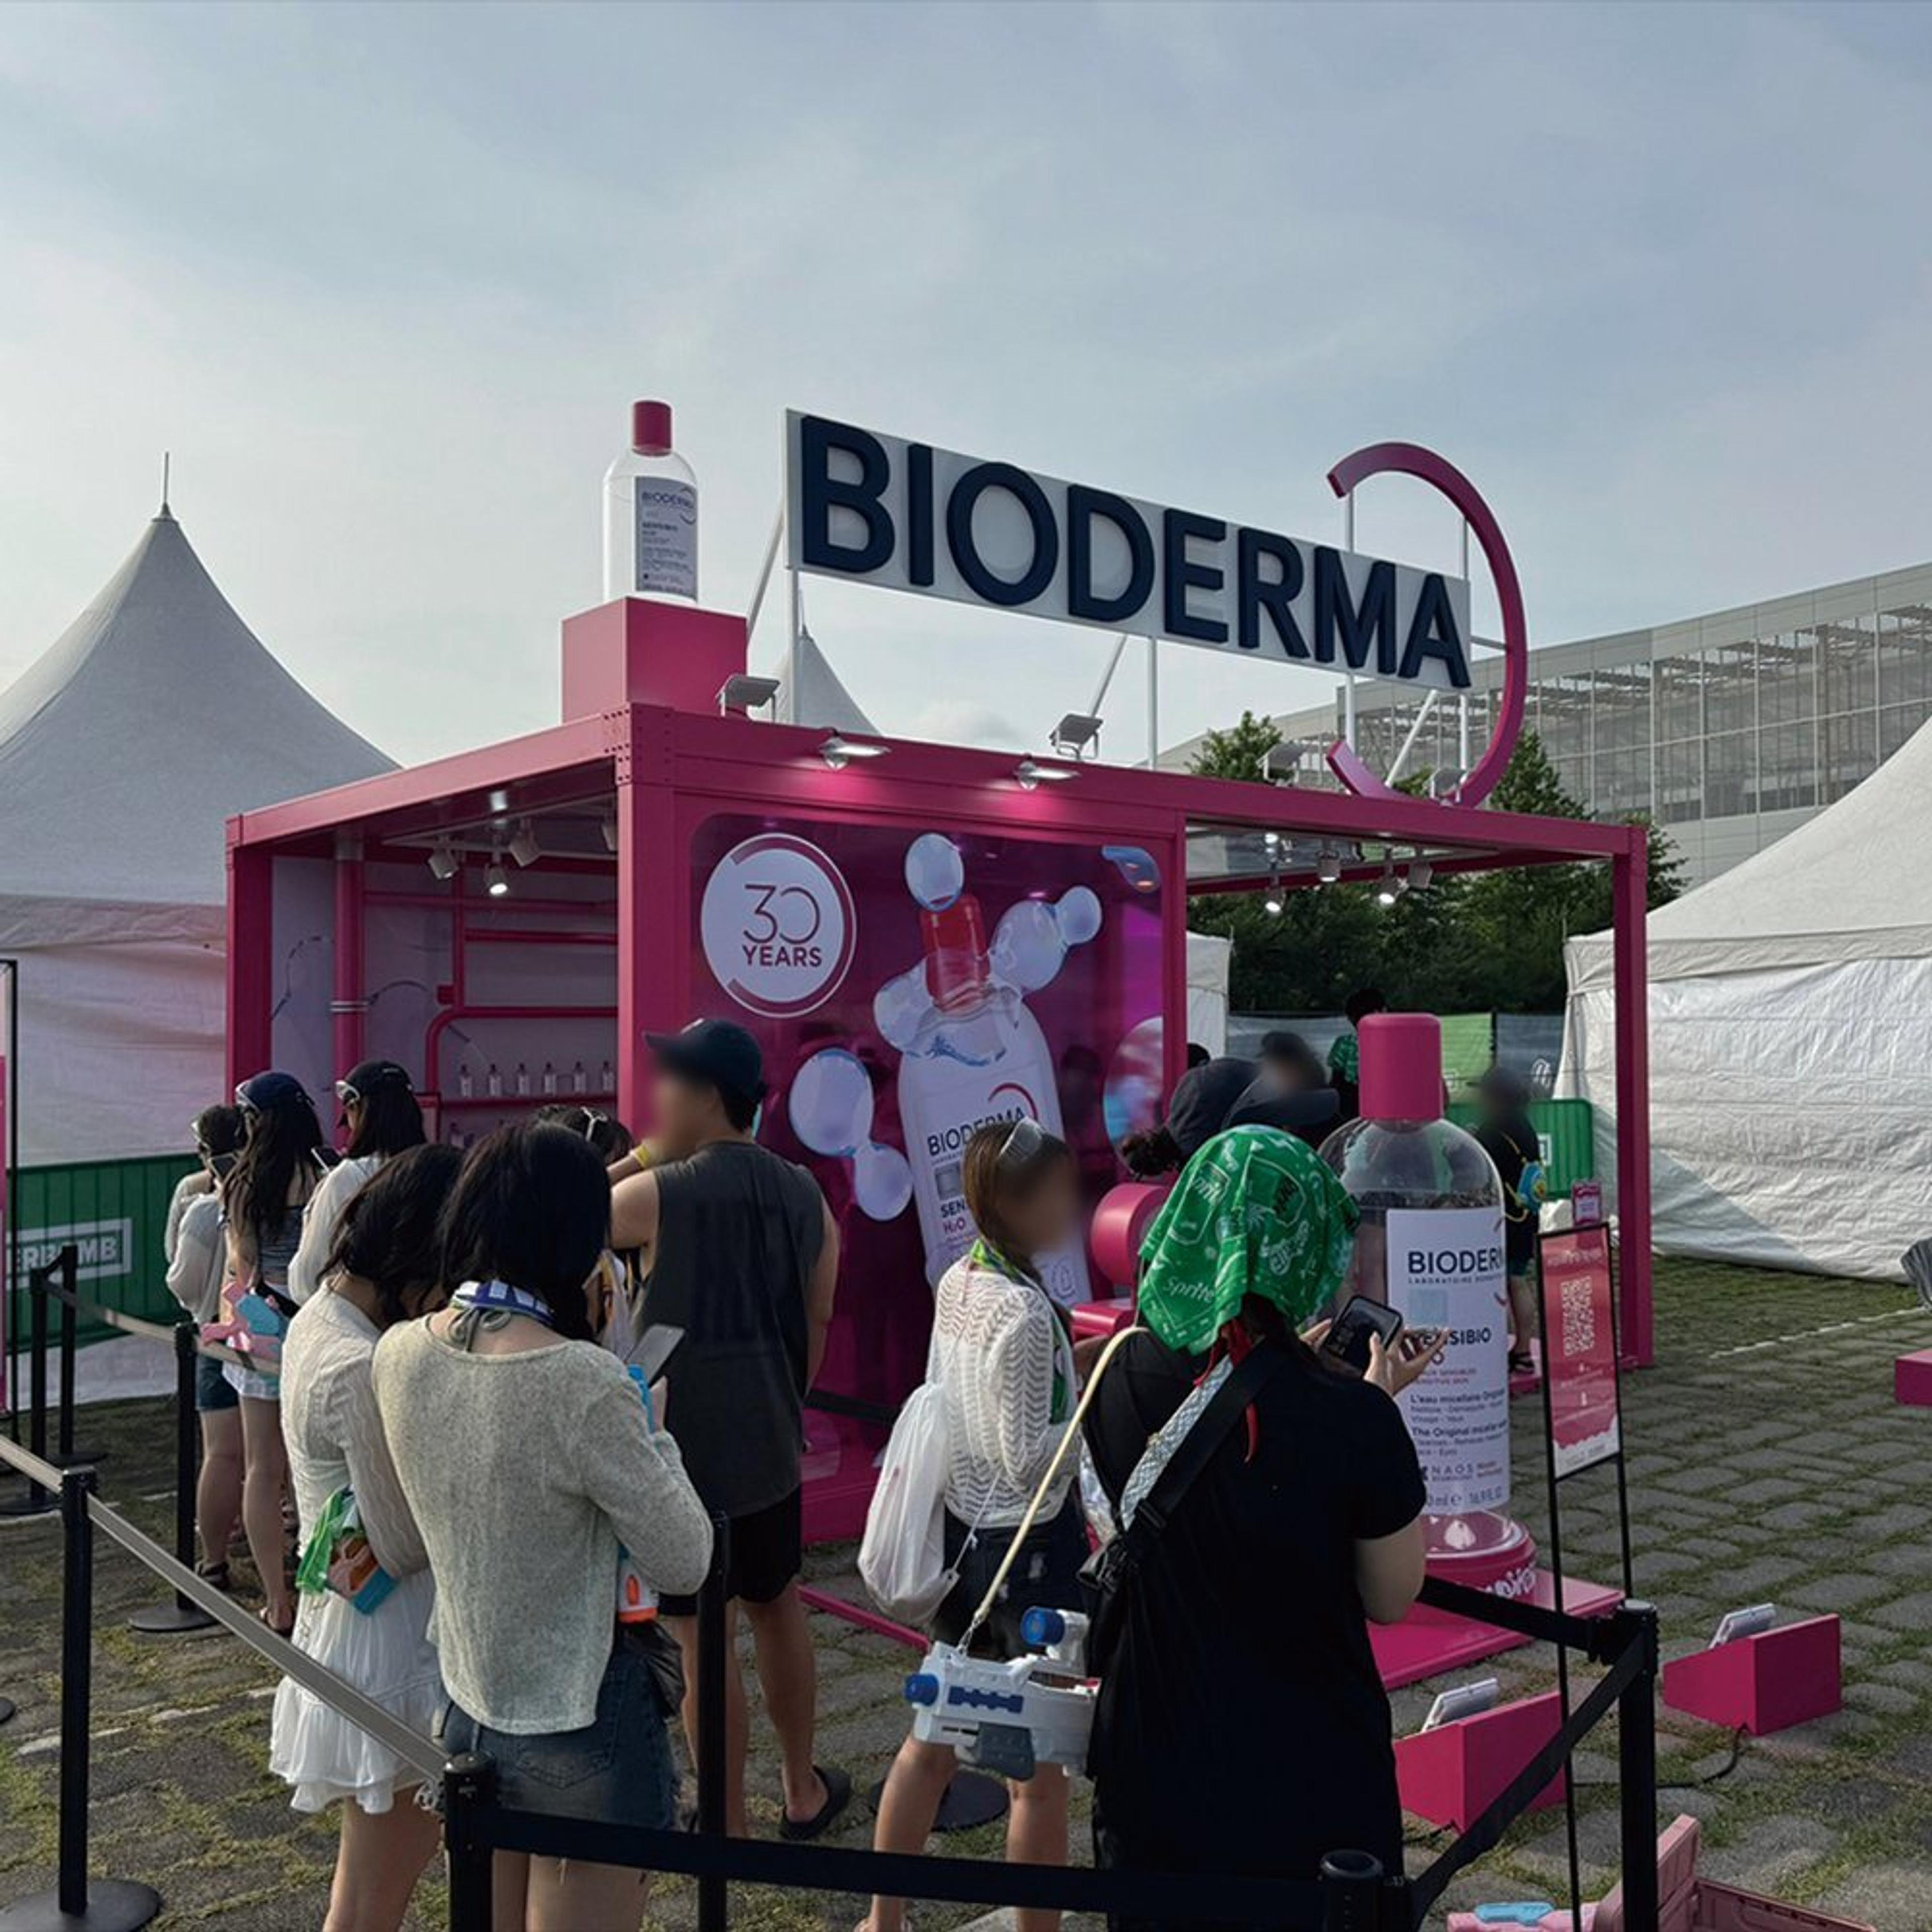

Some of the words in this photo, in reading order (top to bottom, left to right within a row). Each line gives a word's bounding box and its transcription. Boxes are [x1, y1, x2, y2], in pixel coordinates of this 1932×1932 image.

[801, 415, 1472, 688] BIODERMA
[744, 884, 820, 944] 30
[742, 945, 822, 967] YEARS
[1408, 1247, 1502, 1274] BIODER
[1163, 1276, 1214, 1303] Sprite
